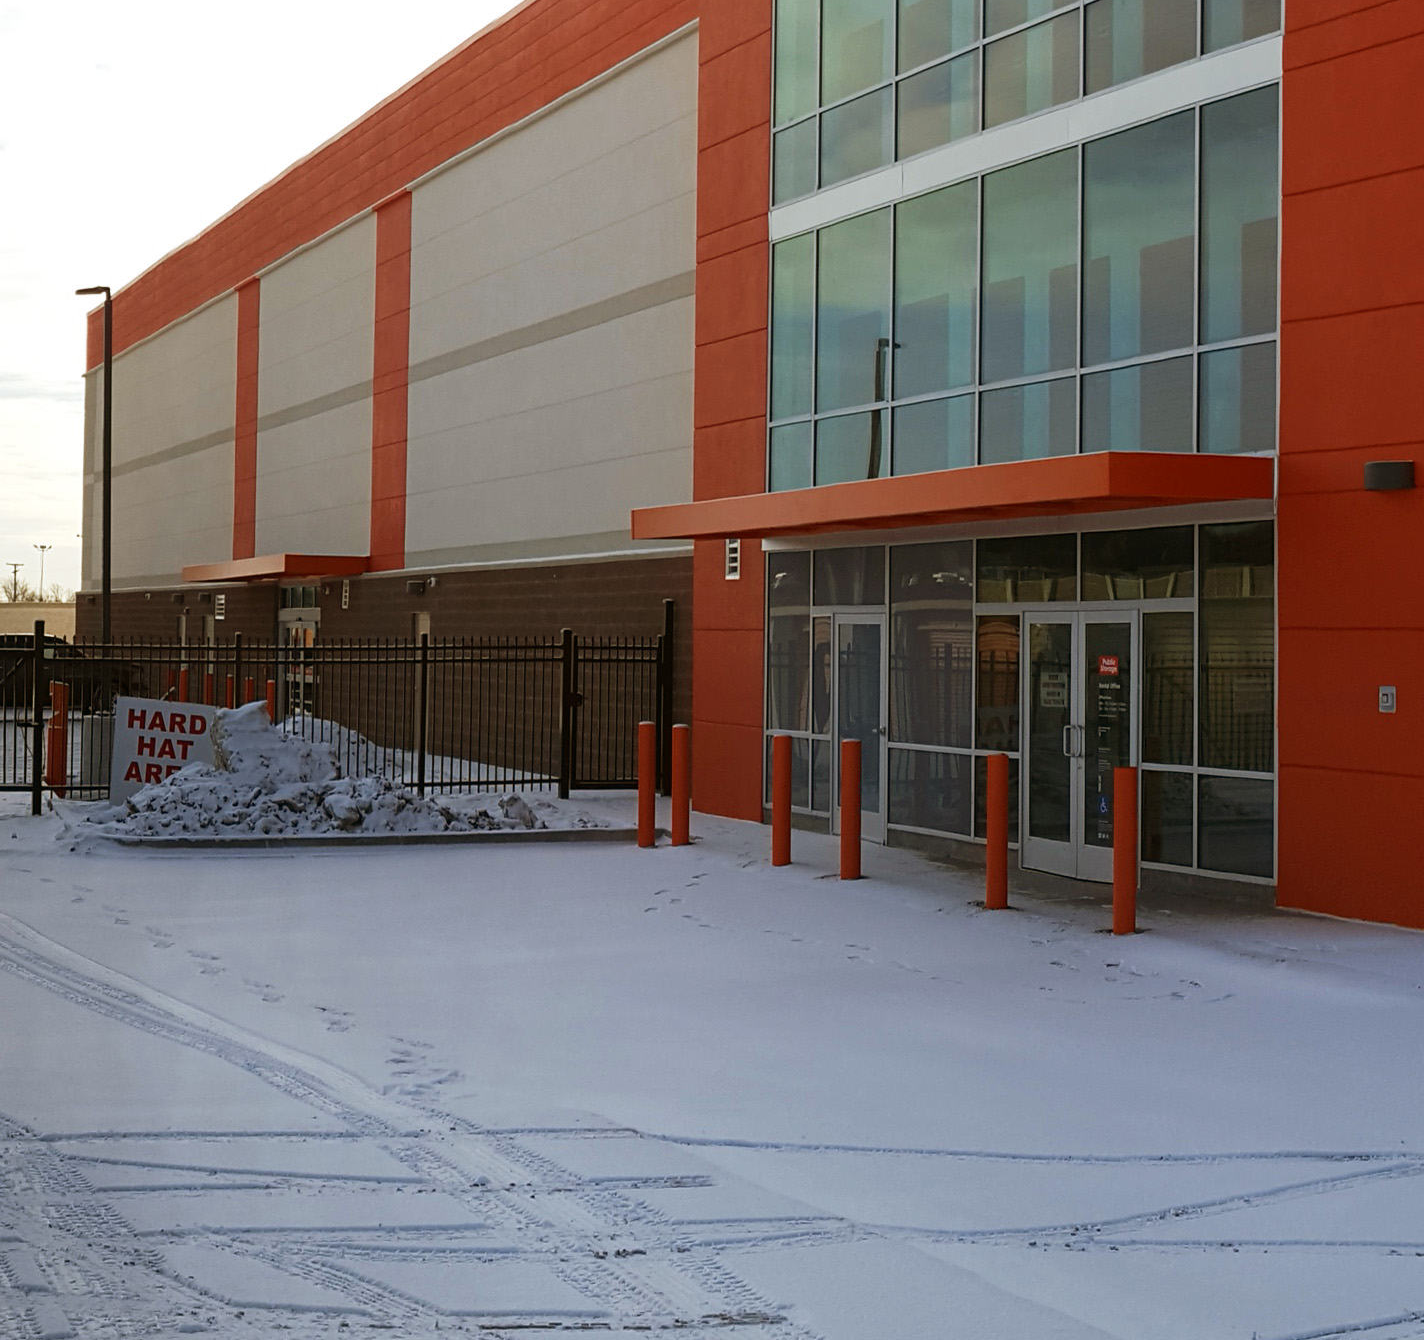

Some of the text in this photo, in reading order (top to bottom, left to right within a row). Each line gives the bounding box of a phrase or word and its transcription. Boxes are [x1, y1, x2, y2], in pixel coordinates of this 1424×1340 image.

[1100, 665, 1117, 674] Storage
[1102, 658, 1116, 666] Public
[127, 708, 207, 735] HARD
[137, 736, 194, 760] HAT
